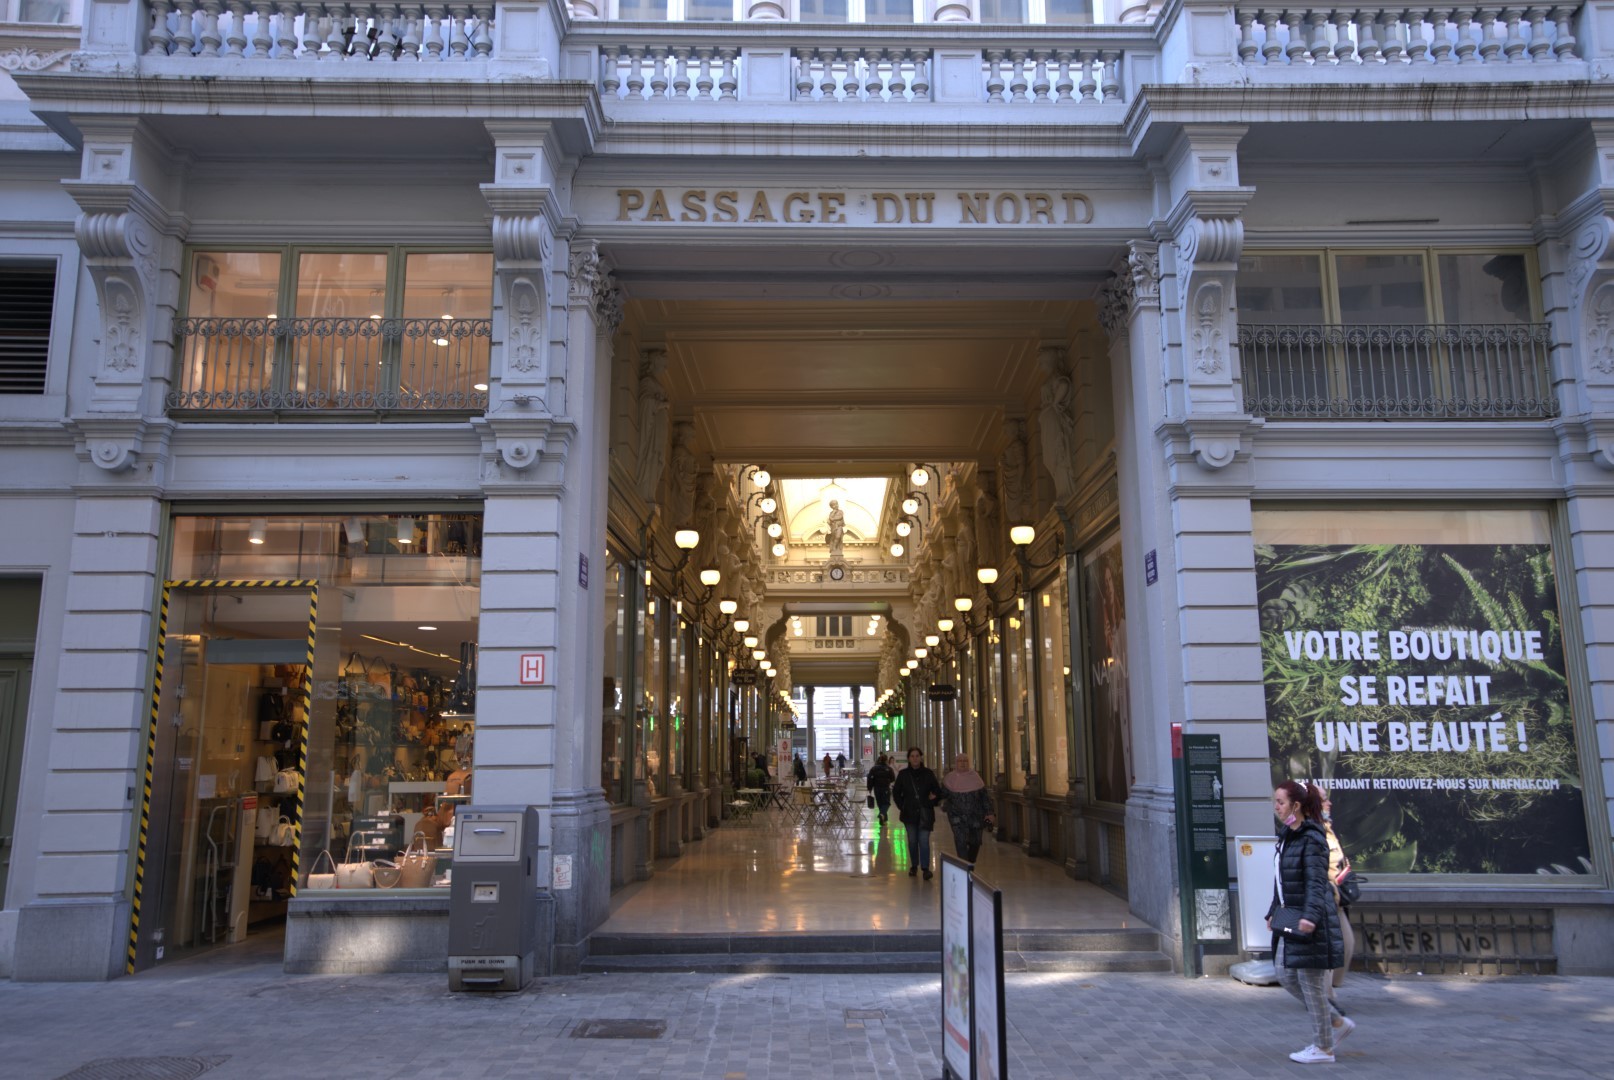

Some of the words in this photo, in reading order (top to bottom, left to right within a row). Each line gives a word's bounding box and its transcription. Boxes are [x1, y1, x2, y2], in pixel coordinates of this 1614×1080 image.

[616, 188, 847, 223] PASSAGE
[872, 191, 935, 224] DU
[958, 191, 1095, 224] NORD
[1284, 630, 1379, 661] VOTRE
[1388, 630, 1544, 664] BOUTIQUE
[526, 659, 539, 678] H
[1339, 675, 1378, 706] SE
[1386, 675, 1491, 706] REFAIT
[1314, 721, 1380, 752] UNE
[1388, 711, 1509, 752] BEAUTÉ
[1516, 721, 1528, 752] !
[1312, 778, 1370, 789] ATTENDANT
[1373, 778, 1466, 790] RETROUVEZ-NOUS
[1468, 778, 1489, 790] SUR
[1492, 778, 1560, 790] NAFNAF.COM
